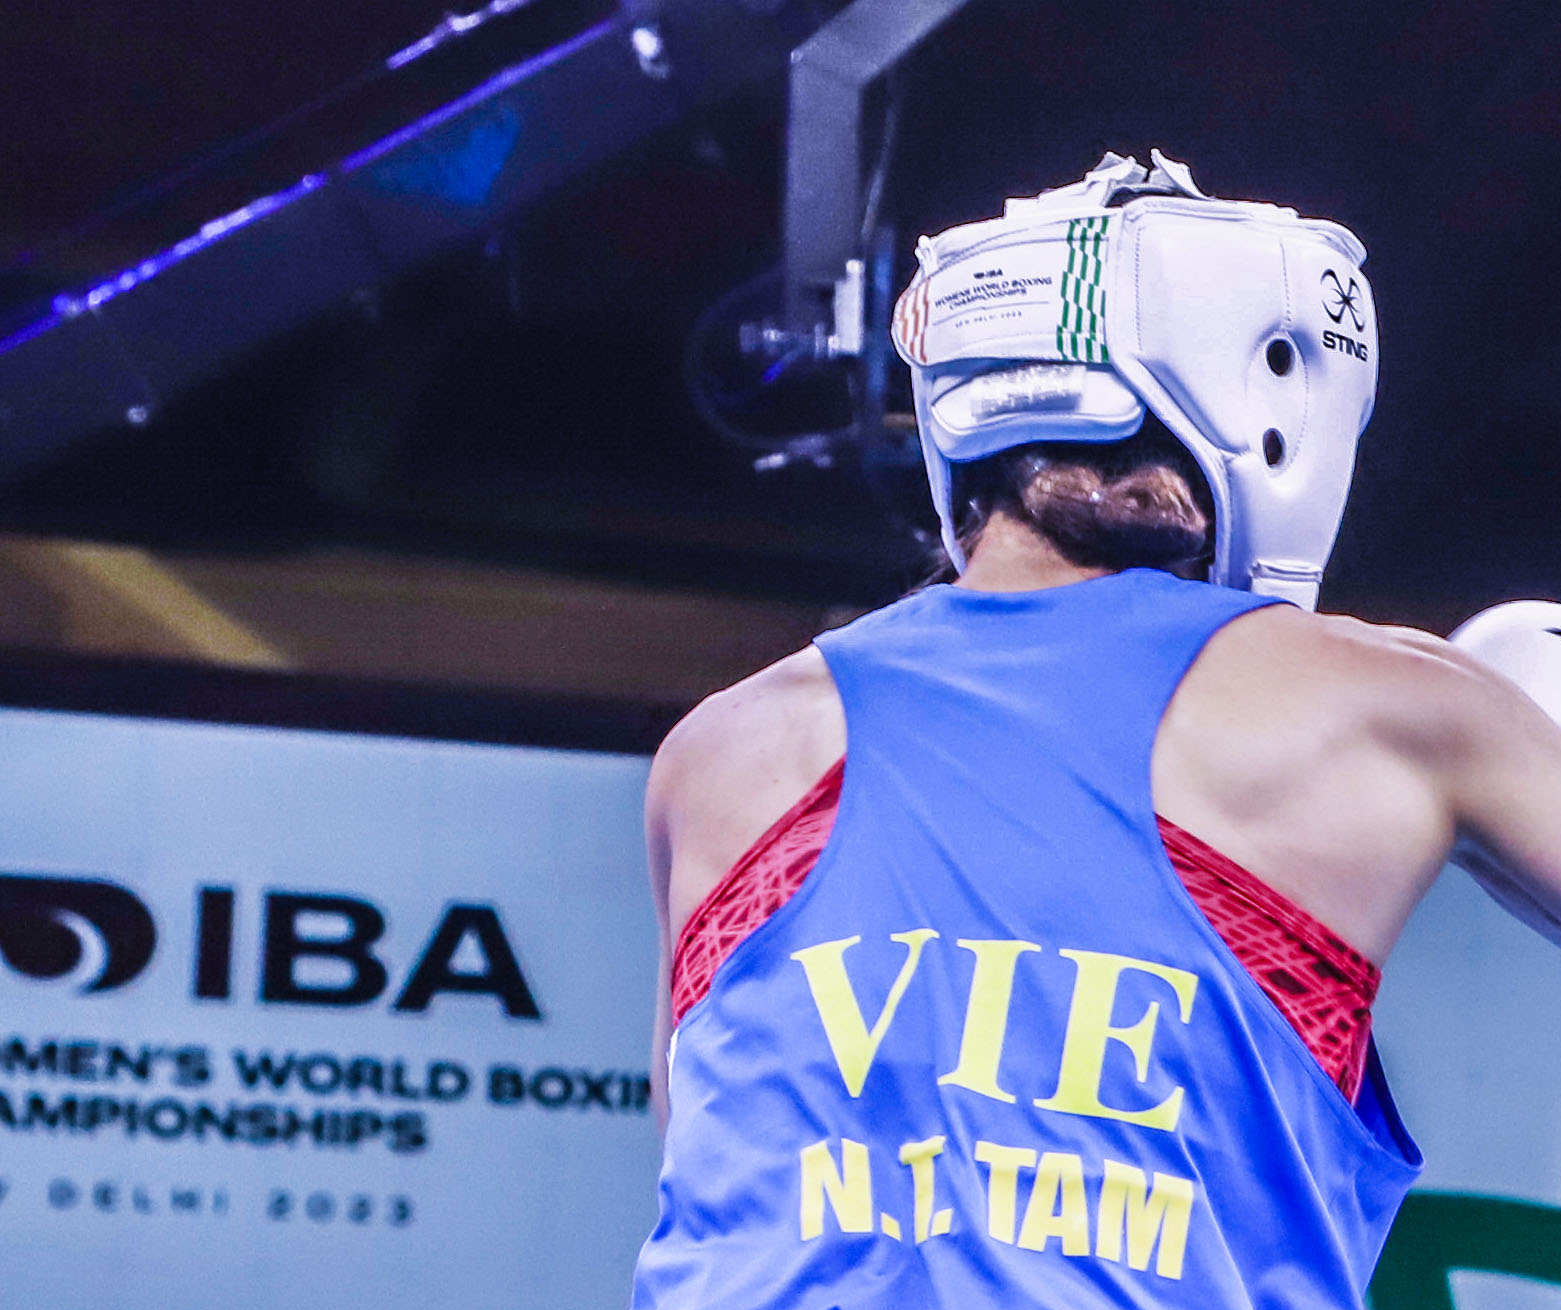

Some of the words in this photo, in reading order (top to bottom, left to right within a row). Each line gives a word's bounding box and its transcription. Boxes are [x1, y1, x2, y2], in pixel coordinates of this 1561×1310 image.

[1322, 329, 1369, 362] STING
[193, 885, 544, 1021] IBA
[232, 1049, 470, 1102] WORLD
[789, 928, 1199, 1132] VIE
[800, 1135, 954, 1245] N.T.
[974, 1140, 1195, 1281] TAM
